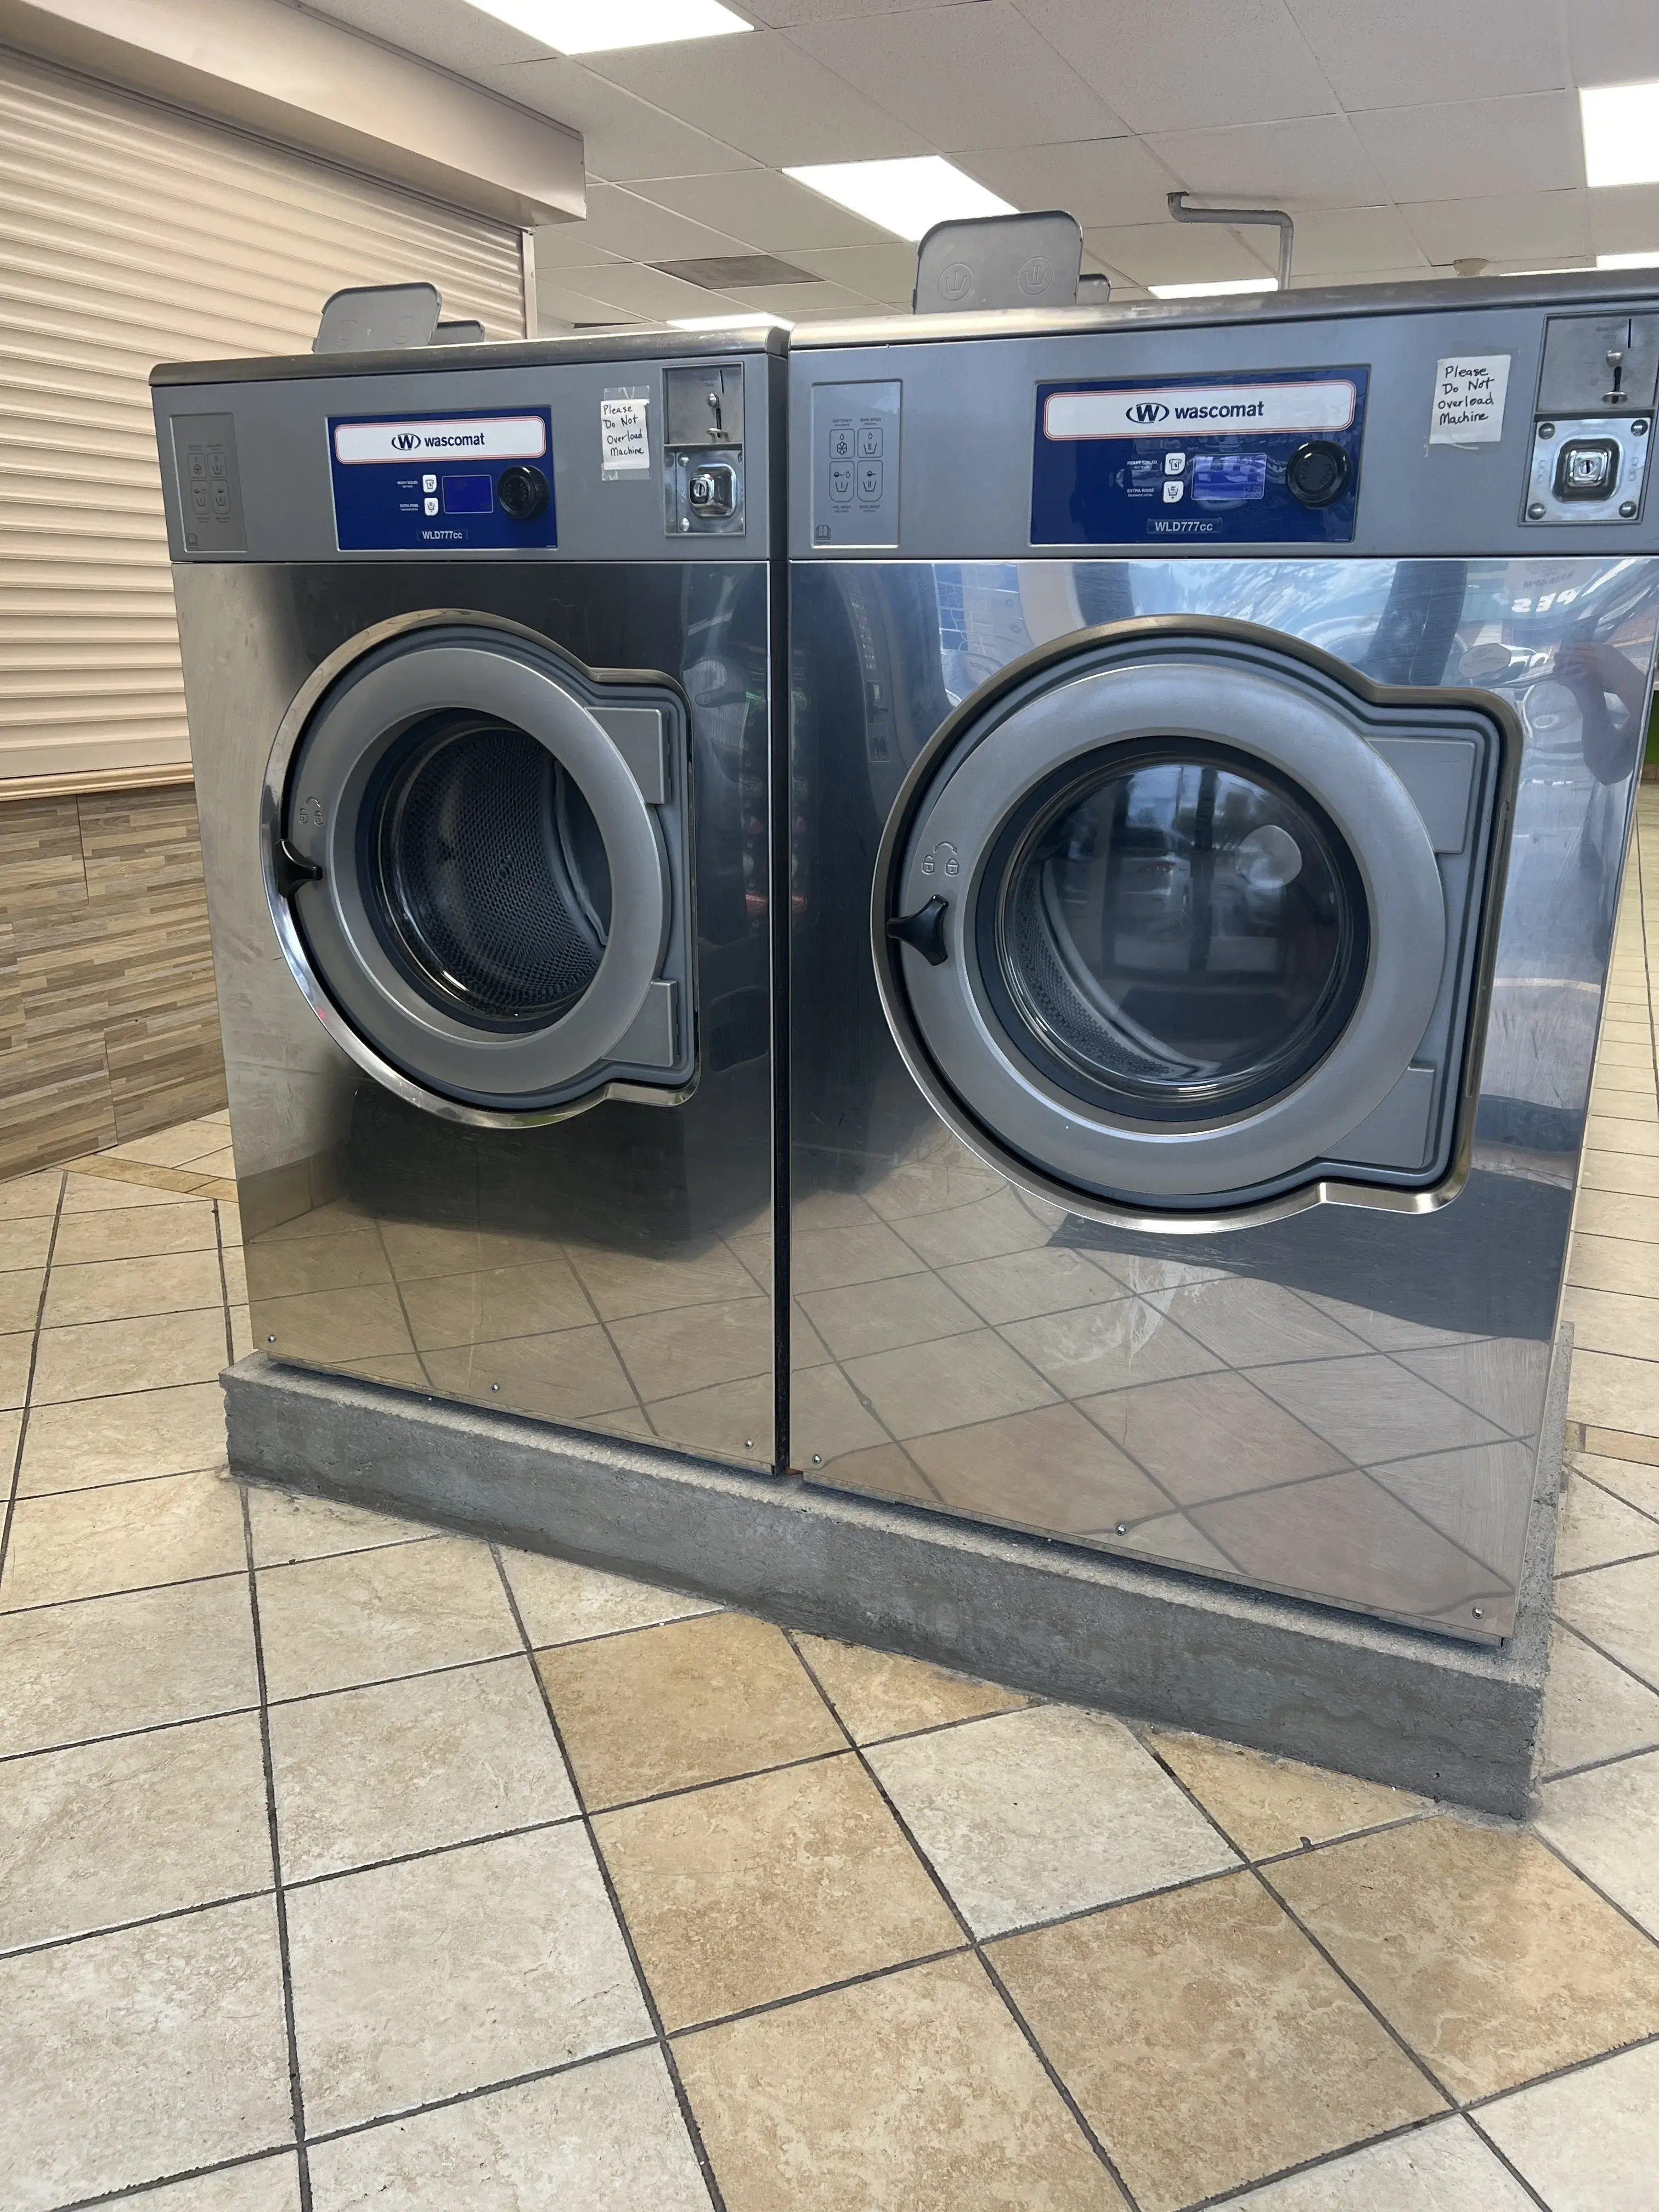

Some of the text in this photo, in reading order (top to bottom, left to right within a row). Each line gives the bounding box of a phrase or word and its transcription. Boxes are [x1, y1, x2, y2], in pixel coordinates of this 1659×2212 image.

[1445, 365, 1489, 379] Please
[1442, 376, 1495, 395] Do Not
[603, 404, 633, 415] Please
[1175, 401, 1264, 419] wascomat
[603, 414, 639, 429] Do Not
[1440, 410, 1489, 426] Machine
[424, 432, 485, 447] wascomat
[607, 428, 643, 444] Overload
[610, 446, 645, 457] Machine
[1155, 521, 1214, 532] WLD777cc
[422, 530, 463, 540] WLD777cc
